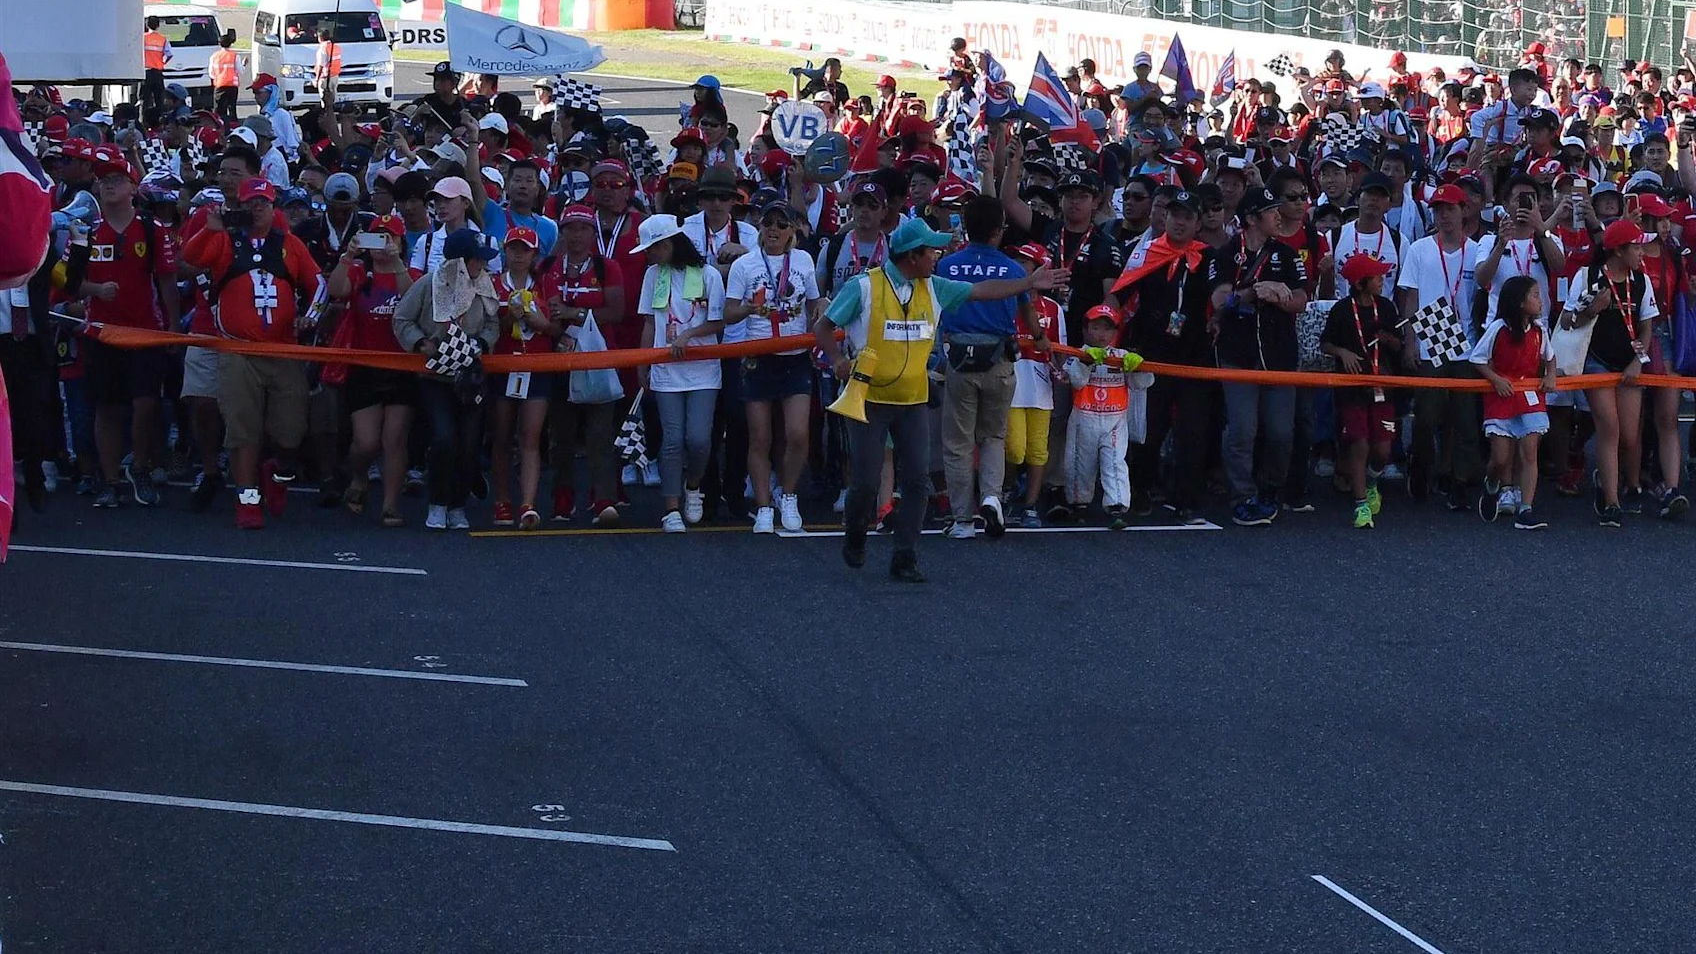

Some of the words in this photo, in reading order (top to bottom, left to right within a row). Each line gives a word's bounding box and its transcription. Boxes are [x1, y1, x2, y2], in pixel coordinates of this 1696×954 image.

[402, 29, 446, 44] DRS
[778, 113, 819, 141] VB
[949, 264, 1009, 277] STAFF
